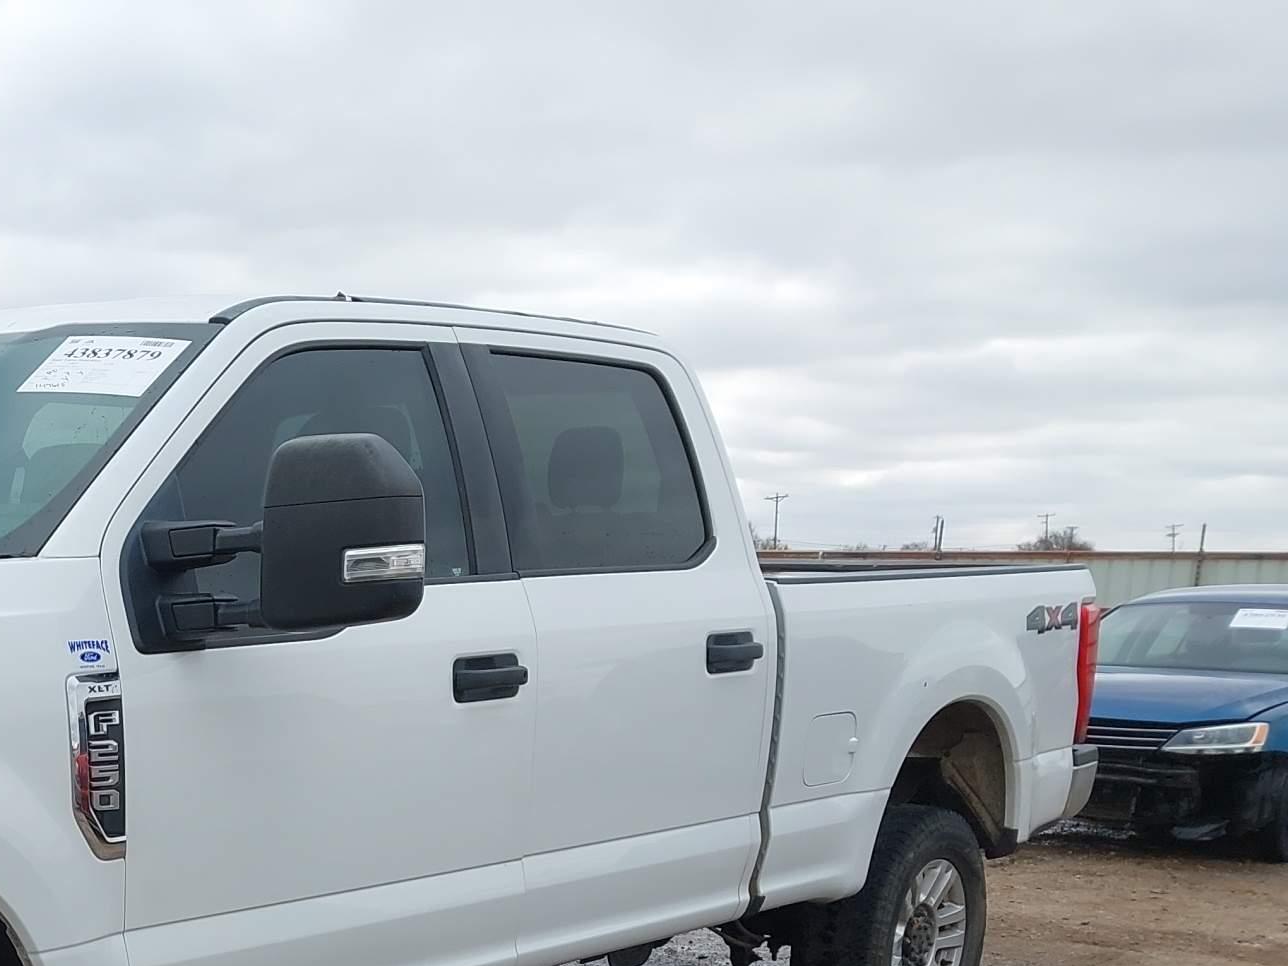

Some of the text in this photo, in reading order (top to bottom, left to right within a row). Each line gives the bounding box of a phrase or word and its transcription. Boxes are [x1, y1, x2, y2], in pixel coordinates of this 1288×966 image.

[64, 347, 162, 361] 43837879
[67, 639, 111, 655] WHITEFACE
[87, 684, 113, 694] XLT
